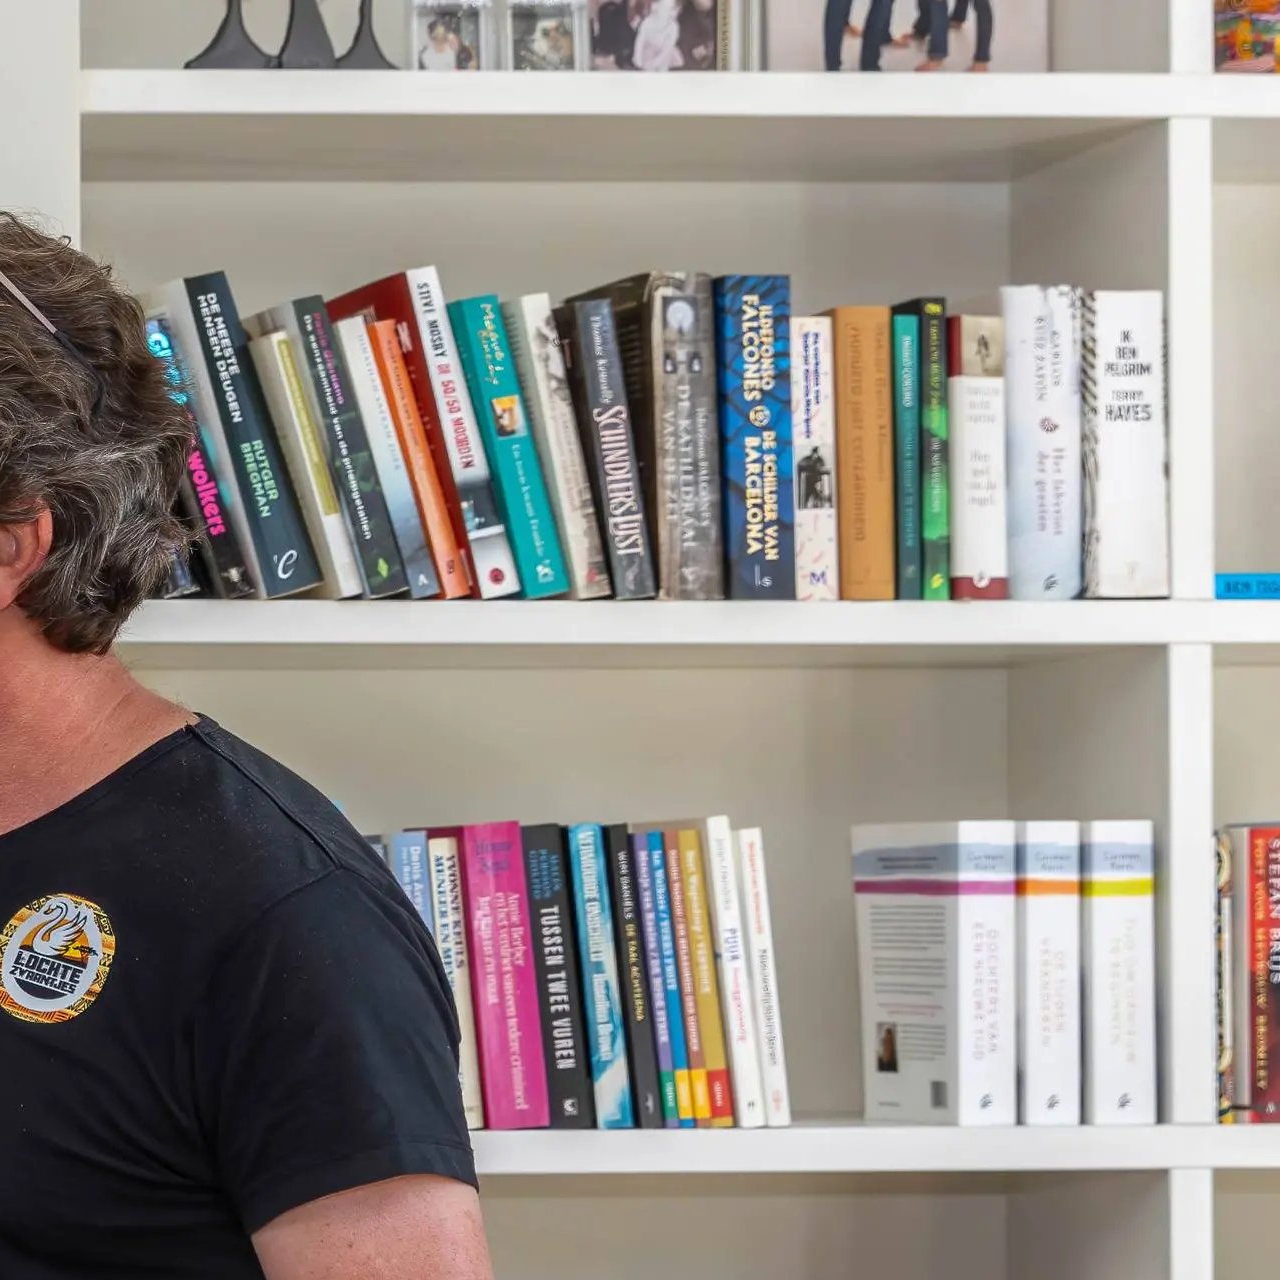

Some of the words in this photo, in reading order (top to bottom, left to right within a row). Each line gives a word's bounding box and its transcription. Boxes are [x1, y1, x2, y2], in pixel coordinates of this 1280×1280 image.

[417, 283, 434, 314] STEVE
[197, 296, 221, 358] MENSEN
[216, 361, 243, 423] DEUGEN
[207, 293, 220, 312] DE
[215, 317, 240, 375] MEESTE
[425, 320, 446, 357] MOSBY
[742, 294, 762, 401] FALCONES
[759, 305, 774, 390] ILDEFONSO
[303, 315, 314, 331] De
[309, 335, 337, 414] eenzaamheid
[331, 418, 343, 438] van
[339, 441, 349, 455] de
[441, 380, 458, 414] 50/50
[762, 431, 776, 450] DE
[188, 451, 226, 536] wolkers
[241, 443, 271, 517] BREGMAN
[252, 440, 279, 499] RUTGER
[745, 436, 763, 555] BARCELONA
[762, 454, 777, 522] SCHILDER
[764, 526, 779, 560] VAN
[410, 846, 422, 881] Denis
[445, 854, 461, 916] YVONNE
[440, 923, 451, 943] EN
[507, 892, 522, 924] Annie
[539, 905, 563, 966] TUSSEN
[511, 926, 526, 966] Berber
[9, 965, 77, 995] ZWAANTJES
[546, 970, 569, 1013] TWEE
[551, 1017, 576, 1070] VUREN
